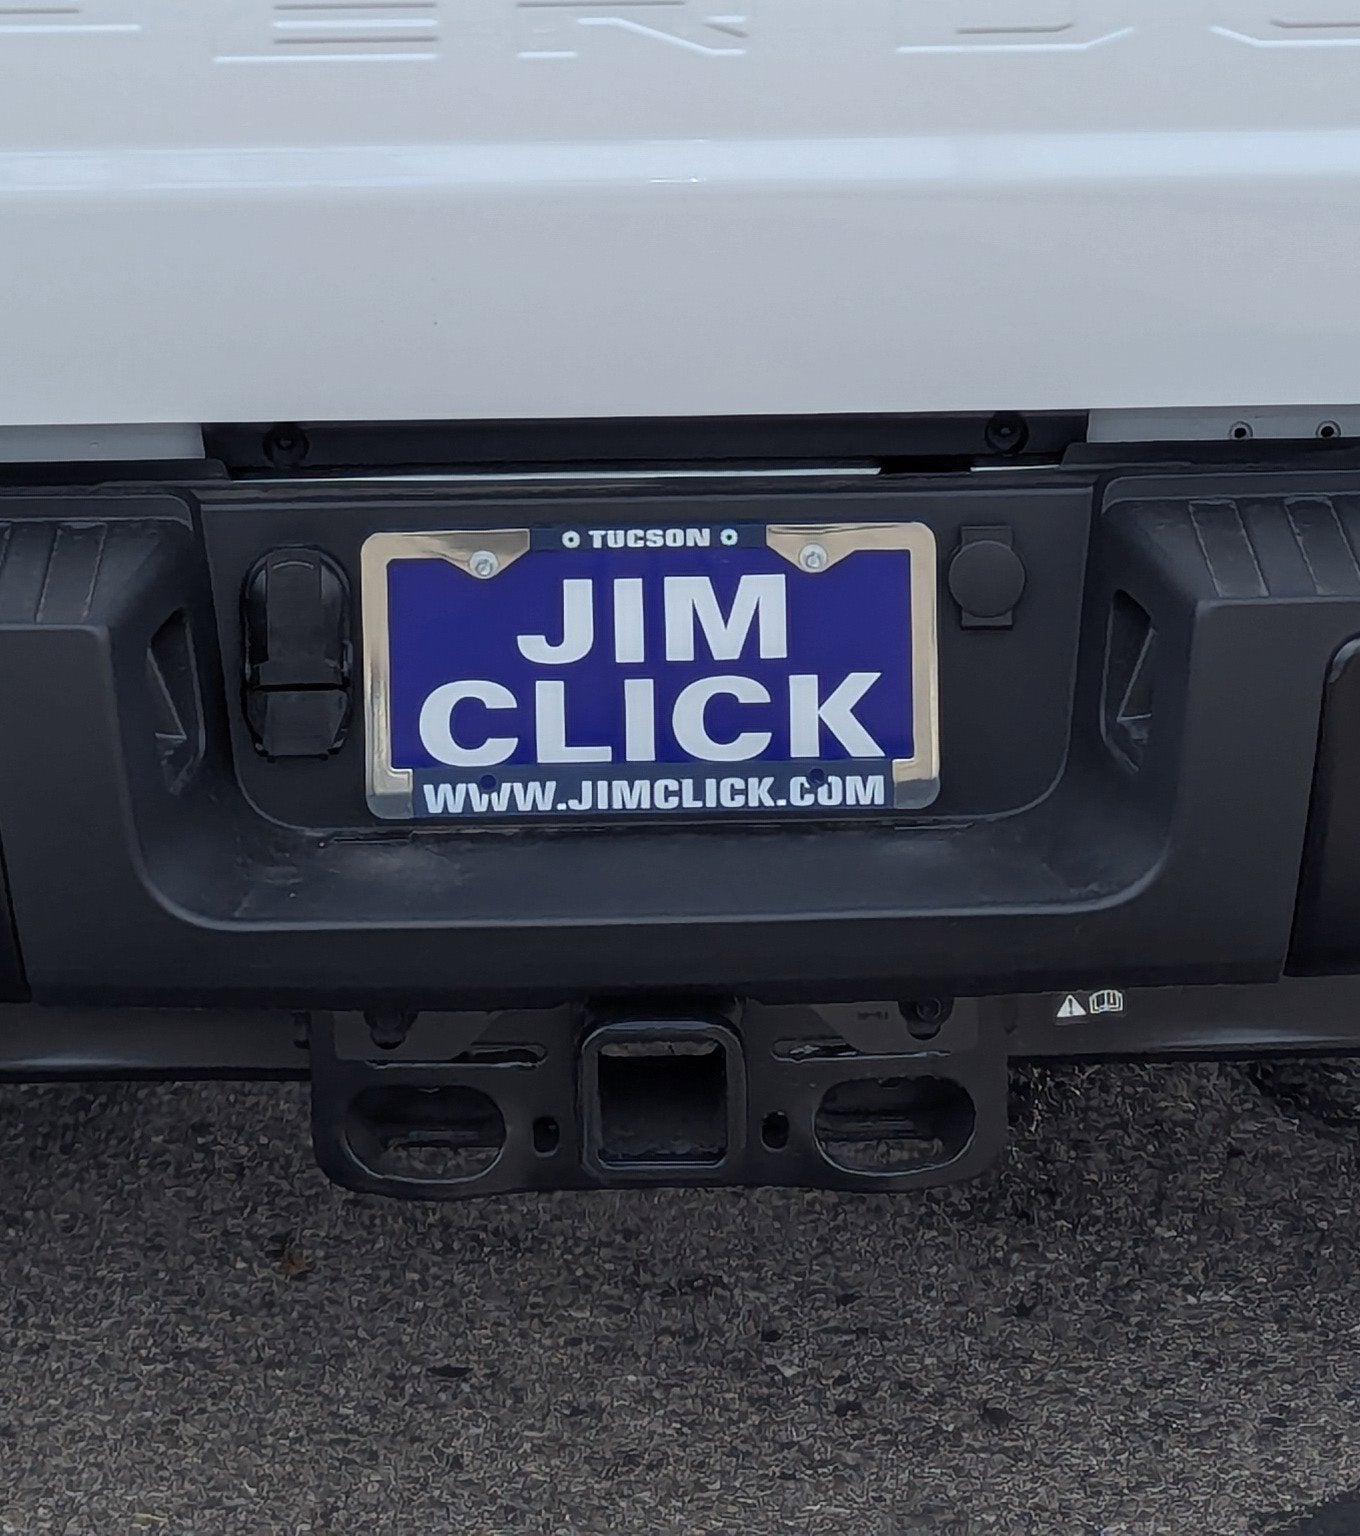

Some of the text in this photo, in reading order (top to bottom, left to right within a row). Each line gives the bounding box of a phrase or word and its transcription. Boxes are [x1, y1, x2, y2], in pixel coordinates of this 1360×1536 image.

[588, 528, 712, 549] TUCSON
[516, 573, 788, 664] JIM
[418, 672, 886, 767] CLICK
[423, 774, 886, 813] WWW.JIMCLICK.COM
